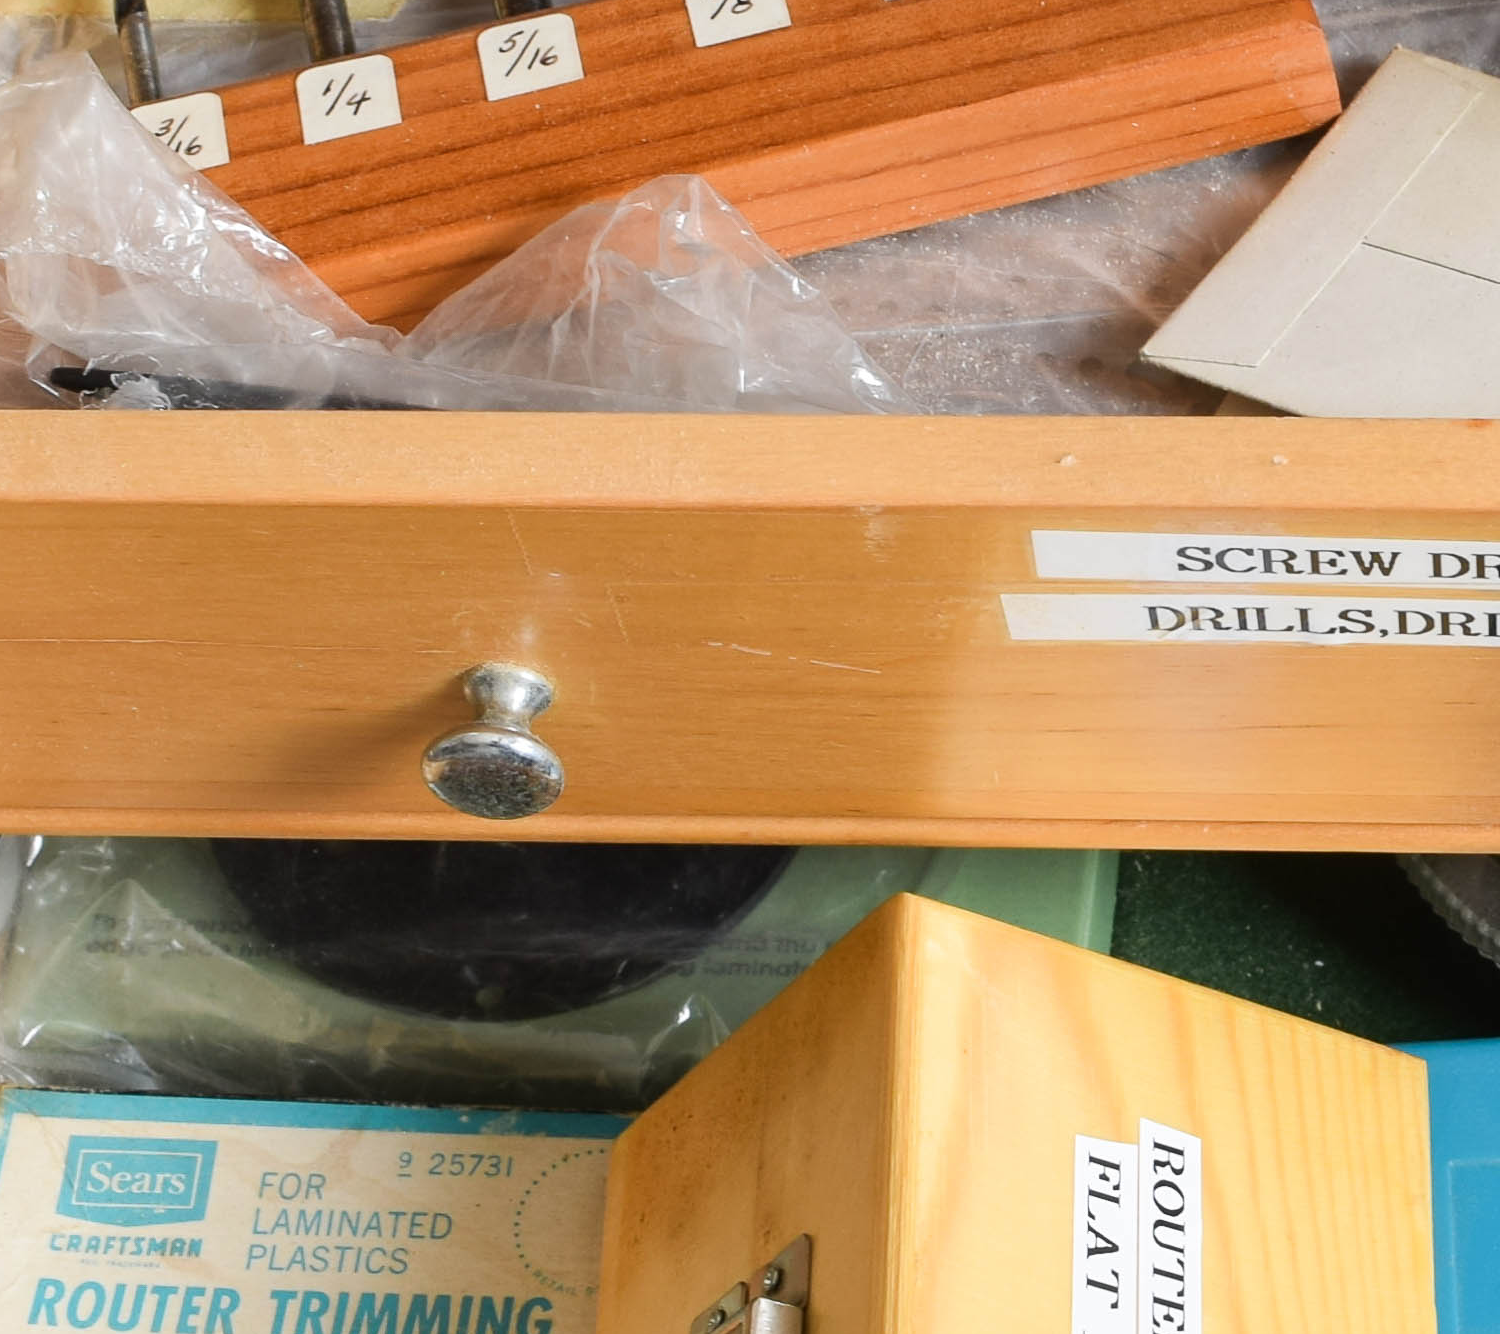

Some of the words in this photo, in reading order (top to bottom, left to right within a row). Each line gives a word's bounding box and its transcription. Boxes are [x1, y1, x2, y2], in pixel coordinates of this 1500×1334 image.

[498, 29, 559, 77] 5/16
[322, 74, 371, 117] 1/4
[1176, 545, 1400, 577] SCREW
[85, 1160, 188, 1196] Sears
[429, 1152, 513, 1177] 25731
[257, 1172, 326, 1200] FOR
[252, 1209, 453, 1239] LAMINATED
[1085, 1150, 1122, 1310] FLAT
[49, 1233, 203, 1257] CRAFTSMAN
[245, 1244, 409, 1274] PLASTICS
